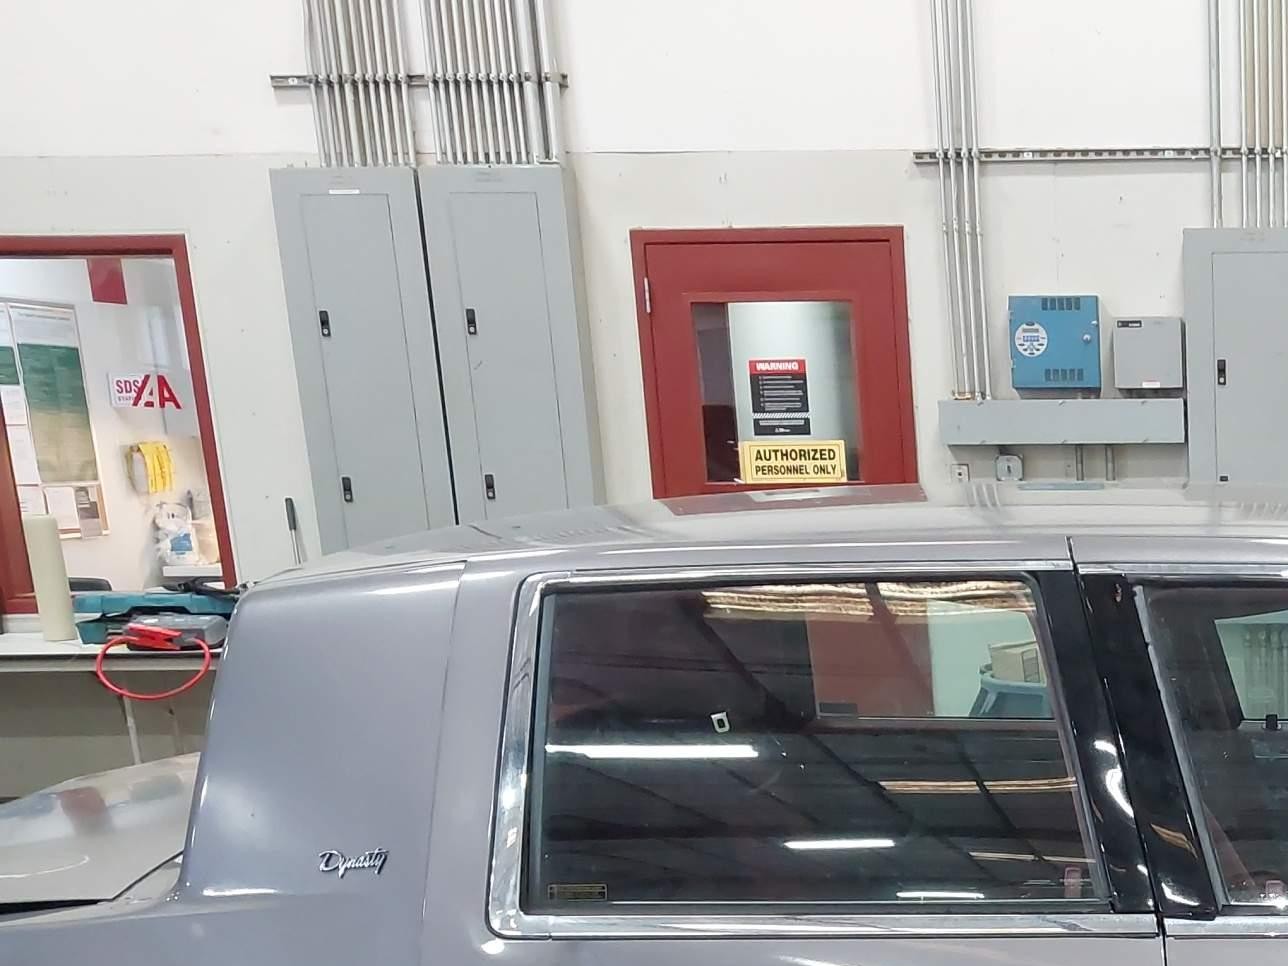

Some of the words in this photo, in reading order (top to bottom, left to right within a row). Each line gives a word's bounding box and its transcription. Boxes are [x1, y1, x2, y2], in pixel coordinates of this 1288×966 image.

[756, 362, 799, 371] WARNING
[755, 448, 836, 461] AUTHORIZED
[755, 464, 810, 476] PERSONNEL
[813, 464, 836, 475] ONLY
[319, 847, 389, 878] Dynasty
